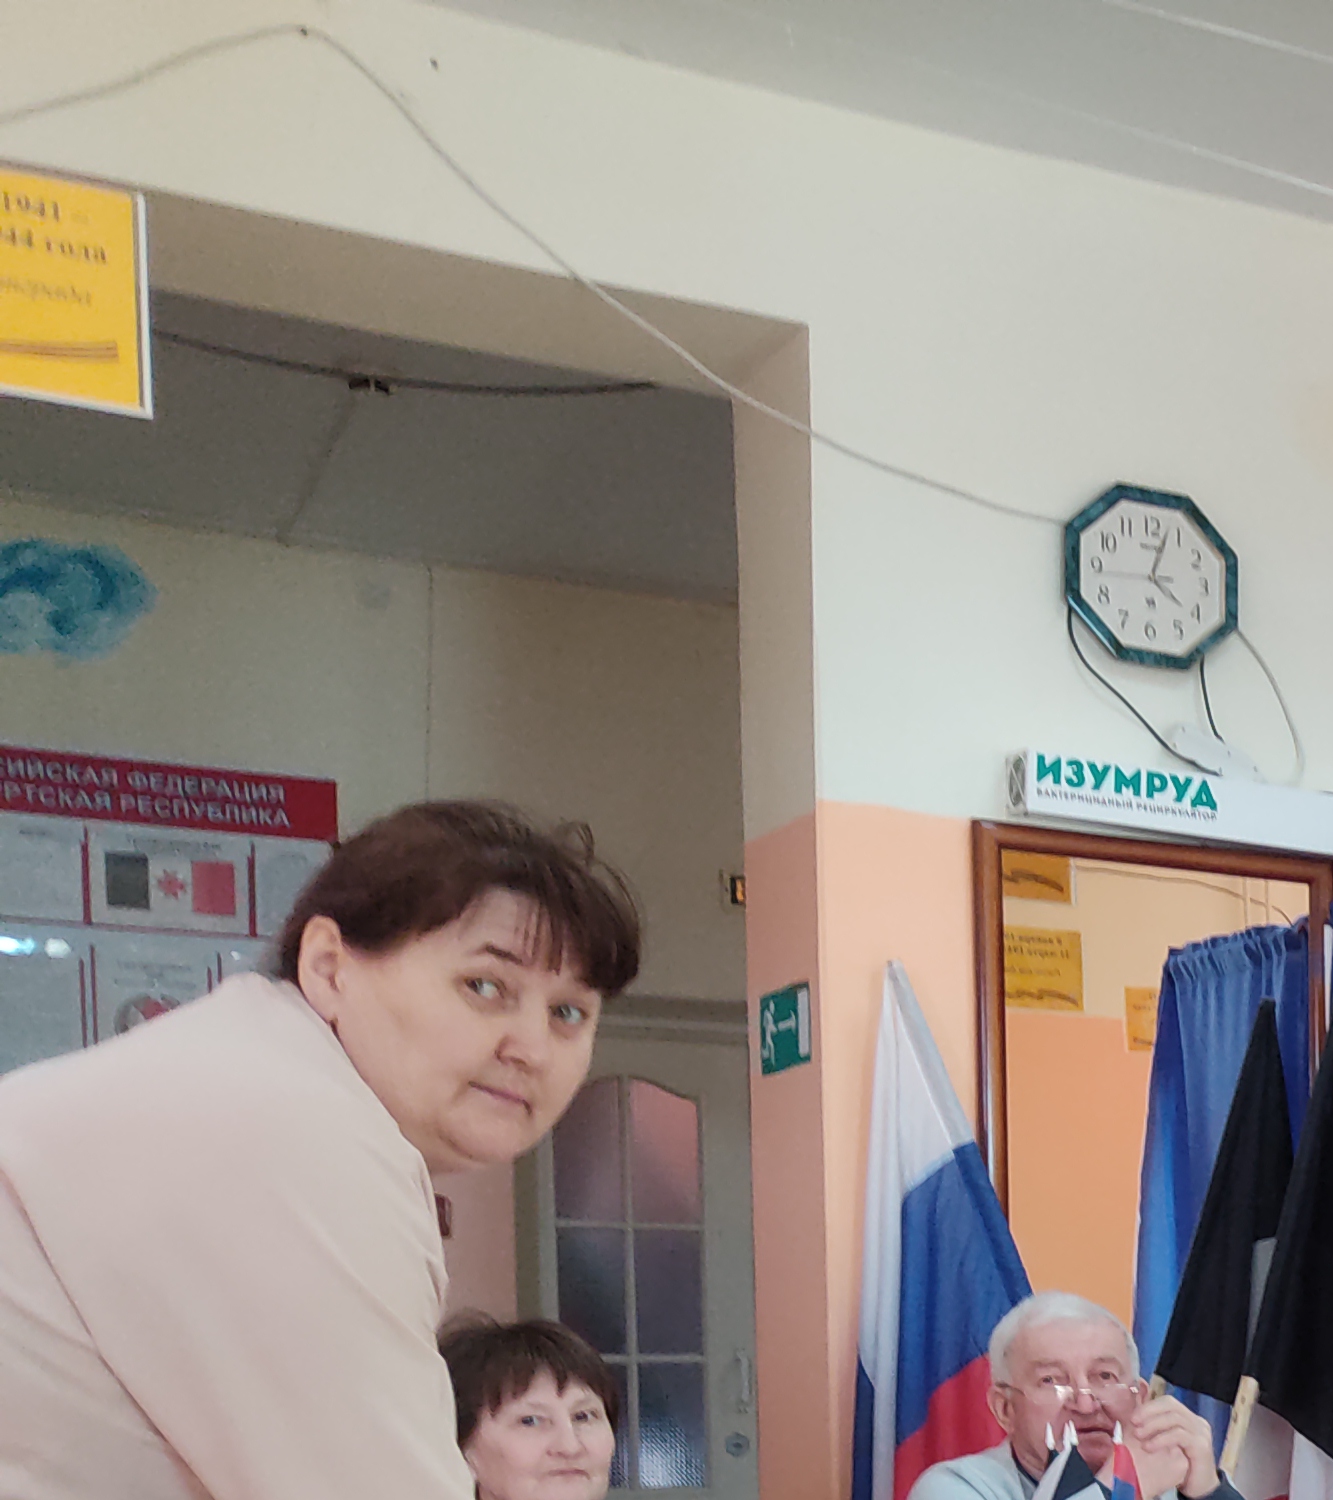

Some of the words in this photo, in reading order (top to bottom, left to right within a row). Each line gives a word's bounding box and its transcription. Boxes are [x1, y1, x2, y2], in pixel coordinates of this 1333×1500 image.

[127, 768, 287, 806] ФЕДЕРАЦИЯ
[1036, 751, 1218, 813] ИЗУМРУД
[119, 792, 292, 830] РЕСПУБЛИКА
